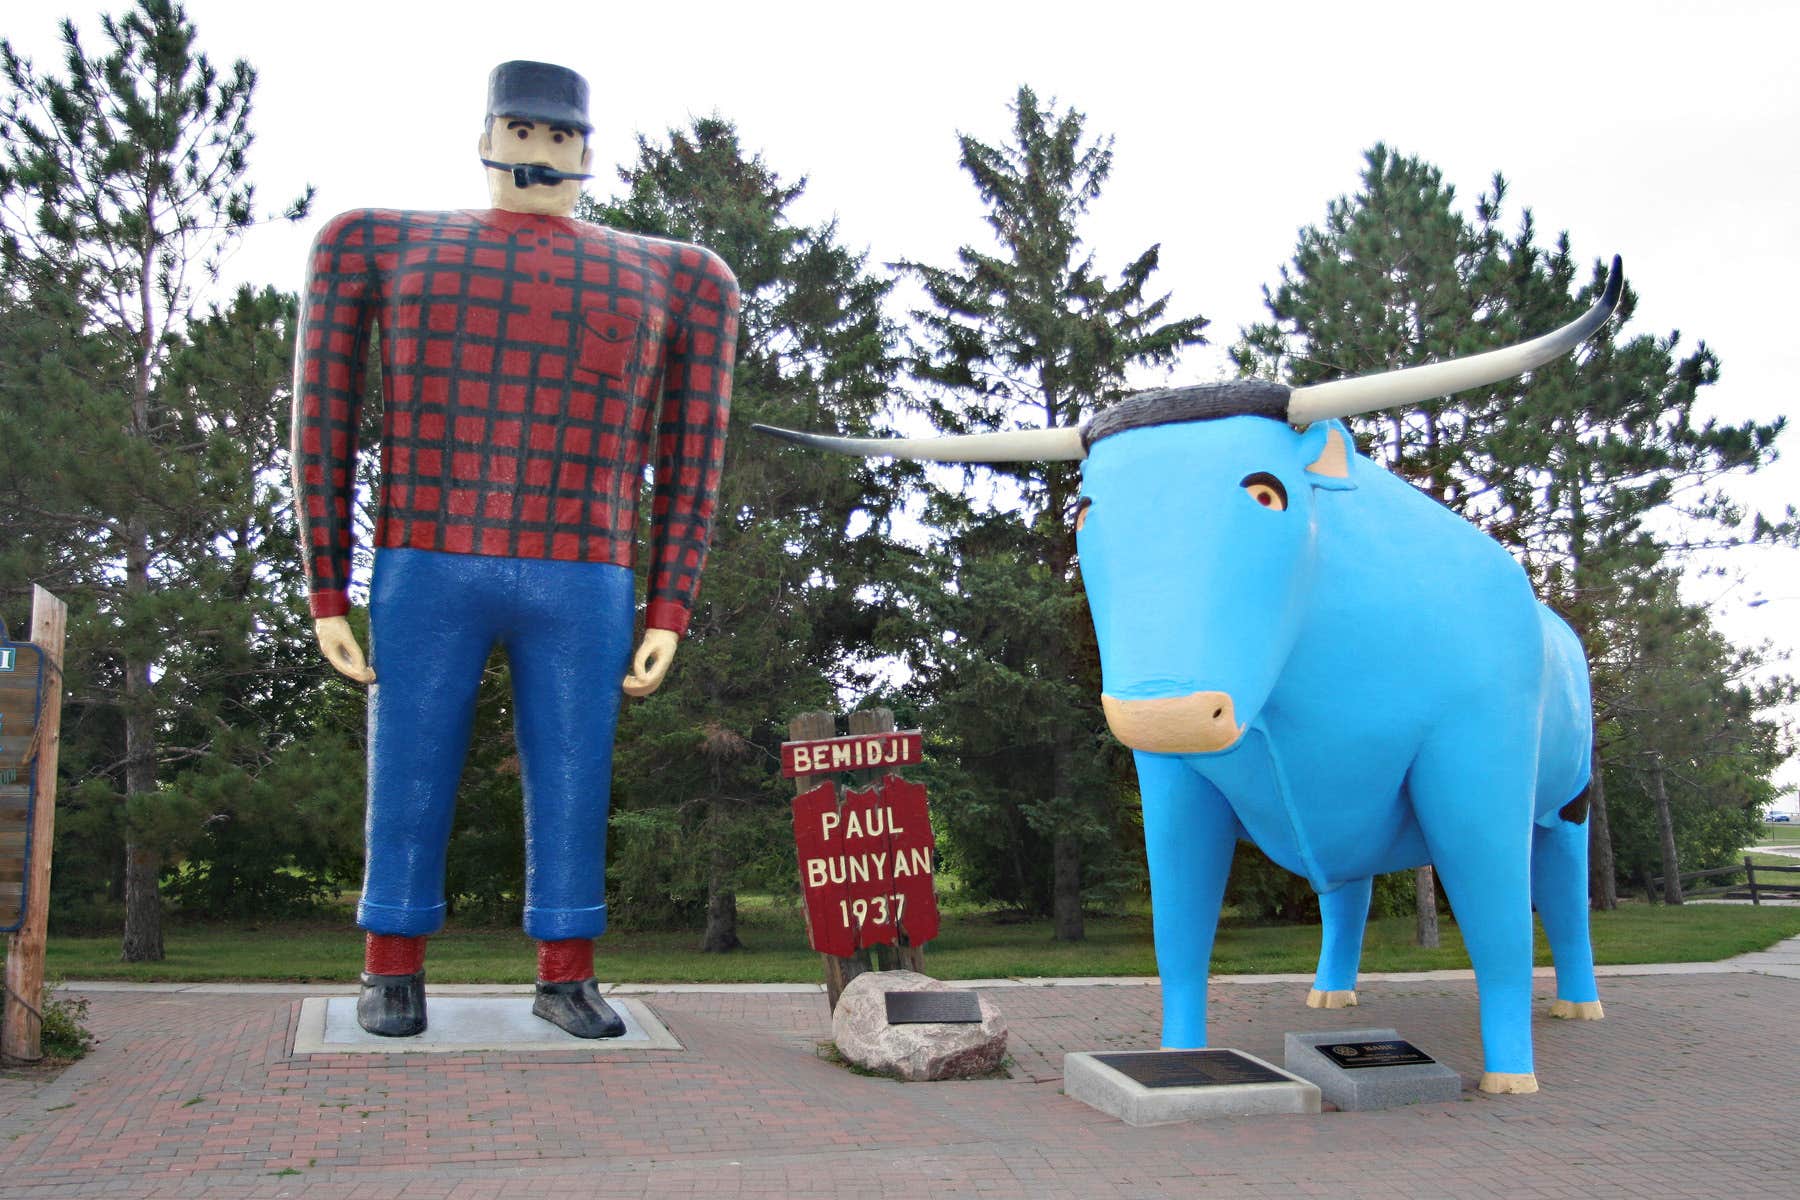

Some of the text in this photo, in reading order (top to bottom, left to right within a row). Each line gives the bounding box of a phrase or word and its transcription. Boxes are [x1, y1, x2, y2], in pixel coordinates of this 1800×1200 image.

[793, 738, 909, 772] BEMIDJI
[822, 807, 903, 840] PAUL
[807, 847, 931, 887] BUNYAN
[840, 894, 905, 927] 1937
